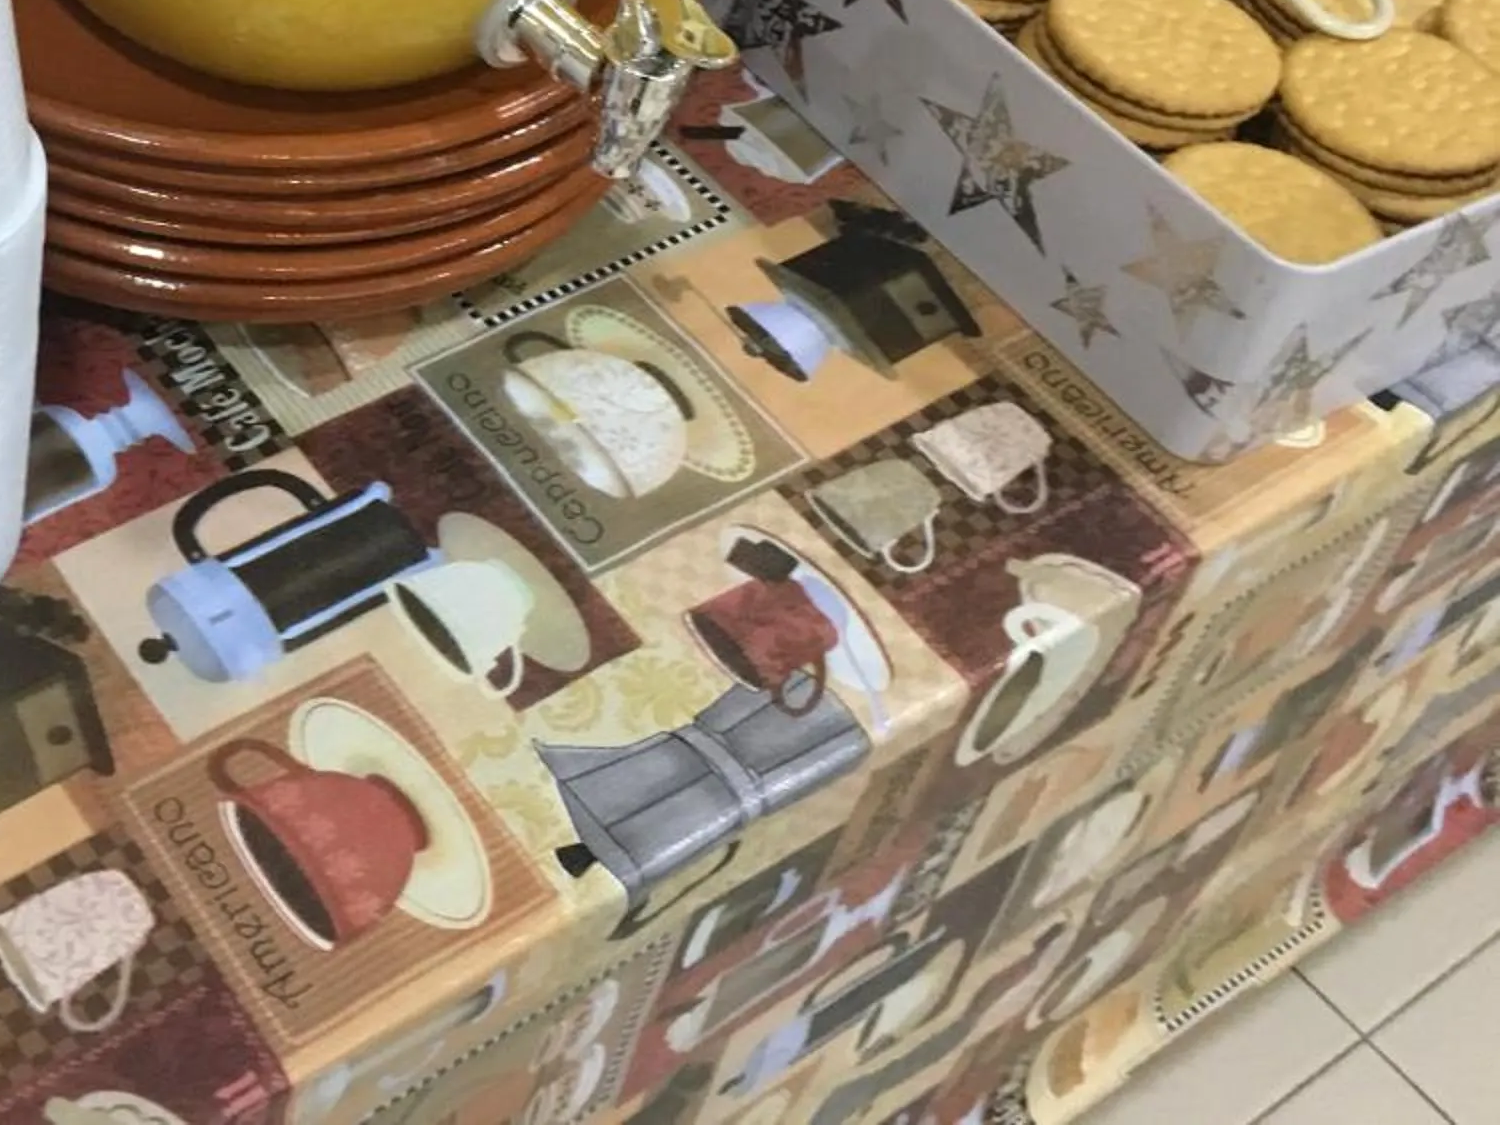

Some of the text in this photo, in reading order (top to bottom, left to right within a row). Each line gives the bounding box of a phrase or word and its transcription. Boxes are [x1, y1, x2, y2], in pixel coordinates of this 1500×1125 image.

[199, 387, 272, 452] Café
[447, 371, 605, 549] Cappuccino
[1022, 350, 1196, 500] Americano
[154, 794, 314, 1011] Americano
